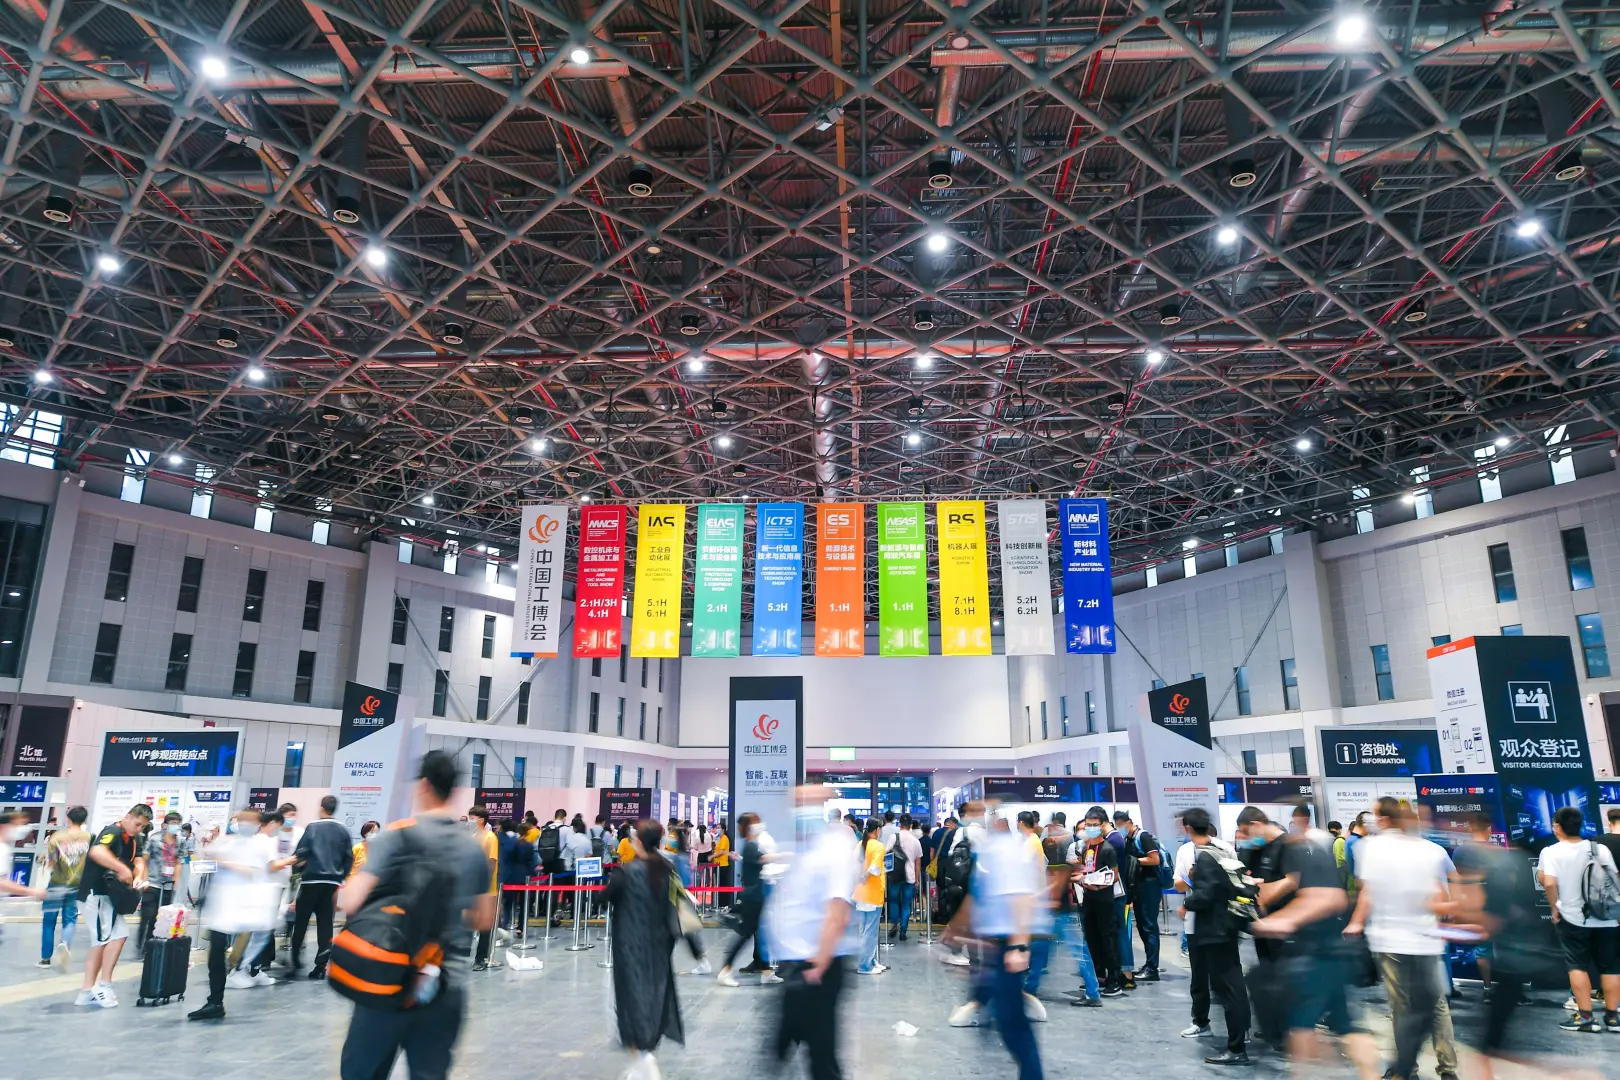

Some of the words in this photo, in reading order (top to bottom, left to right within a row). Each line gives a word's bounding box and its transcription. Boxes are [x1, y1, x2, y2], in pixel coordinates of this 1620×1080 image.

[648, 516, 674, 526] IAS
[766, 516, 794, 526] ICTS
[827, 514, 850, 526] ES
[948, 514, 974, 524] RS
[1008, 514, 1038, 524] STIS
[1074, 540, 1096, 548] 新材料
[530, 549, 552, 640] 中国工博会
[580, 598, 618, 607] 2.1H/3H
[648, 598, 667, 607] 5.1H
[1016, 596, 1037, 604] 5.2H
[1078, 599, 1099, 608] 7.2H
[707, 604, 728, 612] 2.1H
[768, 603, 788, 612] 5.2H
[829, 603, 850, 612] 1.1H
[892, 602, 914, 611] 1.1H
[954, 607, 975, 615] 8.1H
[588, 609, 609, 618] 4.1H
[1442, 730, 1450, 740] 01
[744, 745, 787, 753] 中国工博会
[1464, 739, 1473, 750] 02
[1500, 738, 1580, 758] 观众登记
[20, 745, 43, 756] 北馆
[1360, 743, 1399, 756] 咨询处
[132, 749, 208, 760] VIP参观团接应点
[745, 770, 788, 779] 智能、互联
